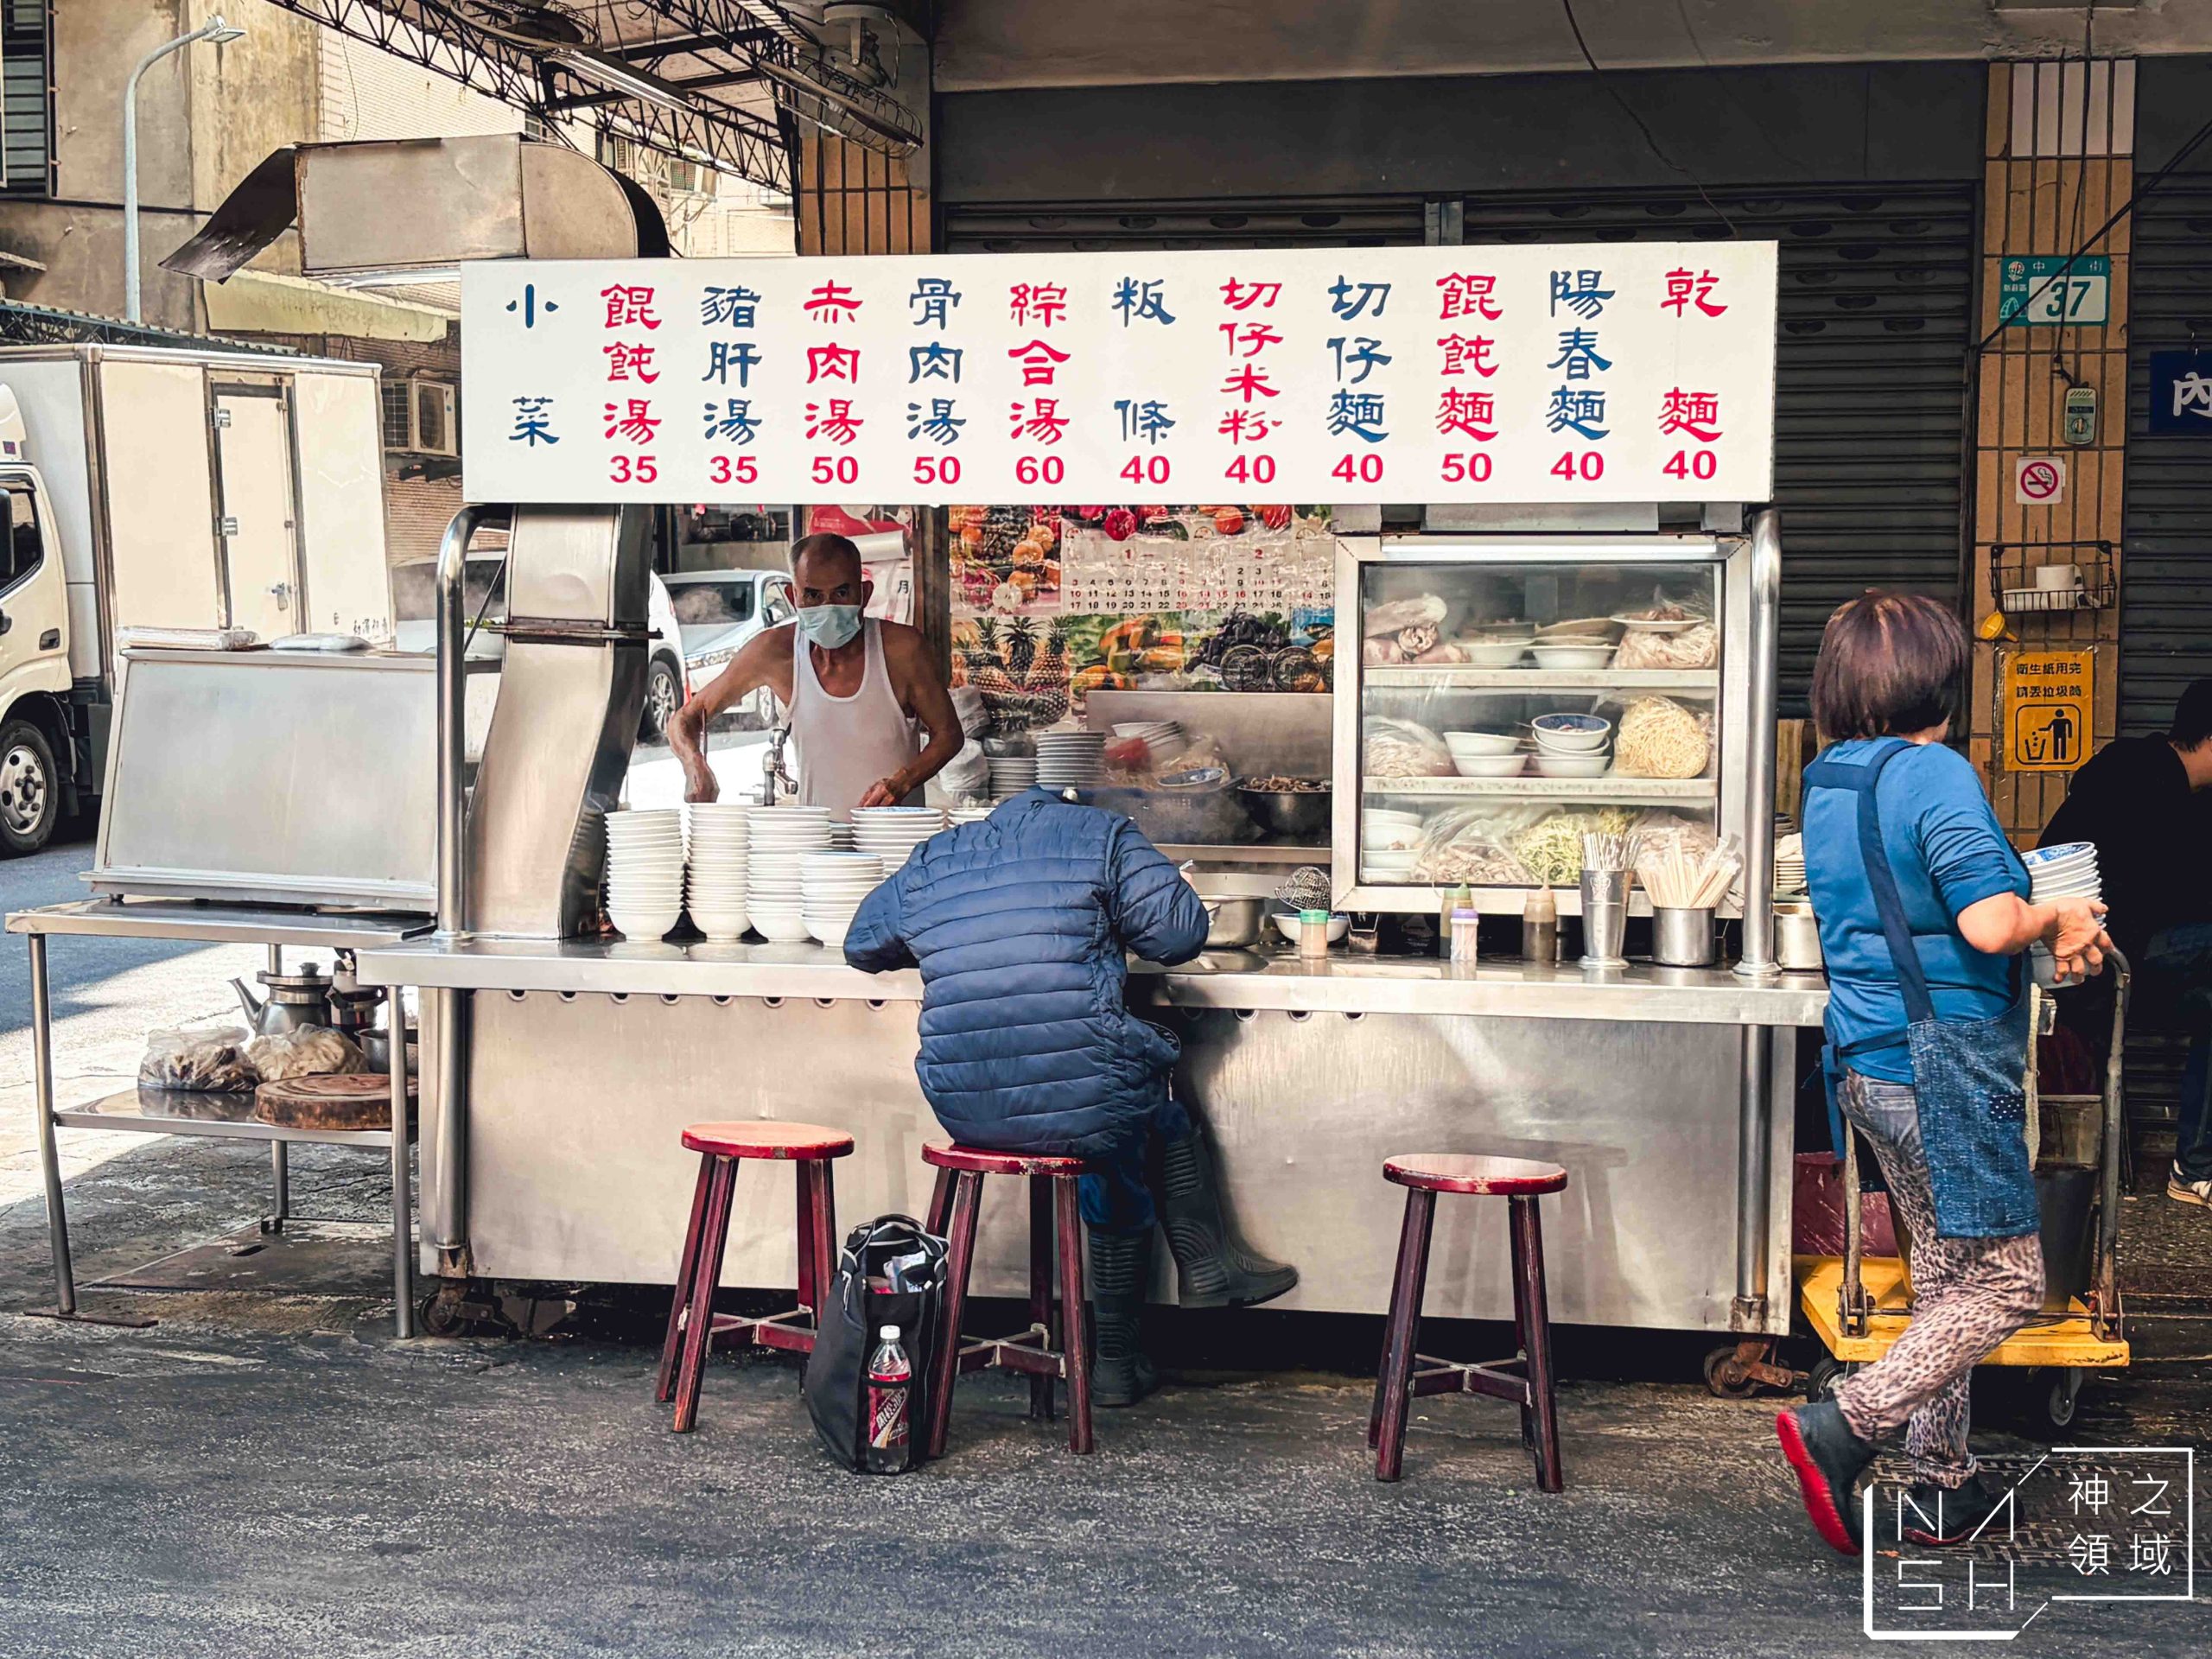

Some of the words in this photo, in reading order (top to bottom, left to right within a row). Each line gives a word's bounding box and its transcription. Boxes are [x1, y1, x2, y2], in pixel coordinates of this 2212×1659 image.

[2046, 281, 2091, 317] 37
[506, 284, 559, 447] 小菜
[601, 283, 662, 445] 餛飩湯
[702, 285, 762, 445] 豬肝湯
[804, 279, 863, 445] 赤肉湯
[907, 278, 966, 445] 骨肉湯
[1008, 282, 1071, 445] 綜合湯
[1218, 277, 1283, 445] 切仔米粉
[1327, 275, 1392, 442] 切仔麵
[1436, 272, 1503, 442] 餛飩麵
[1546, 270, 1615, 440] 陽春麵
[1659, 267, 1728, 442] 乾麵
[611, 455, 657, 484] 35
[710, 456, 758, 484] 35
[812, 456, 858, 484] 50
[914, 456, 960, 484] 50
[1016, 456, 1064, 484] 60
[1121, 456, 1170, 484] 40
[1225, 455, 1275, 483] 40
[1332, 454, 1382, 483] 40
[1442, 453, 1491, 482] 50
[1550, 452, 1604, 480] 40
[1662, 450, 1716, 480] 40
[1254, 549, 1264, 560] 2
[897, 580, 910, 594] 月
